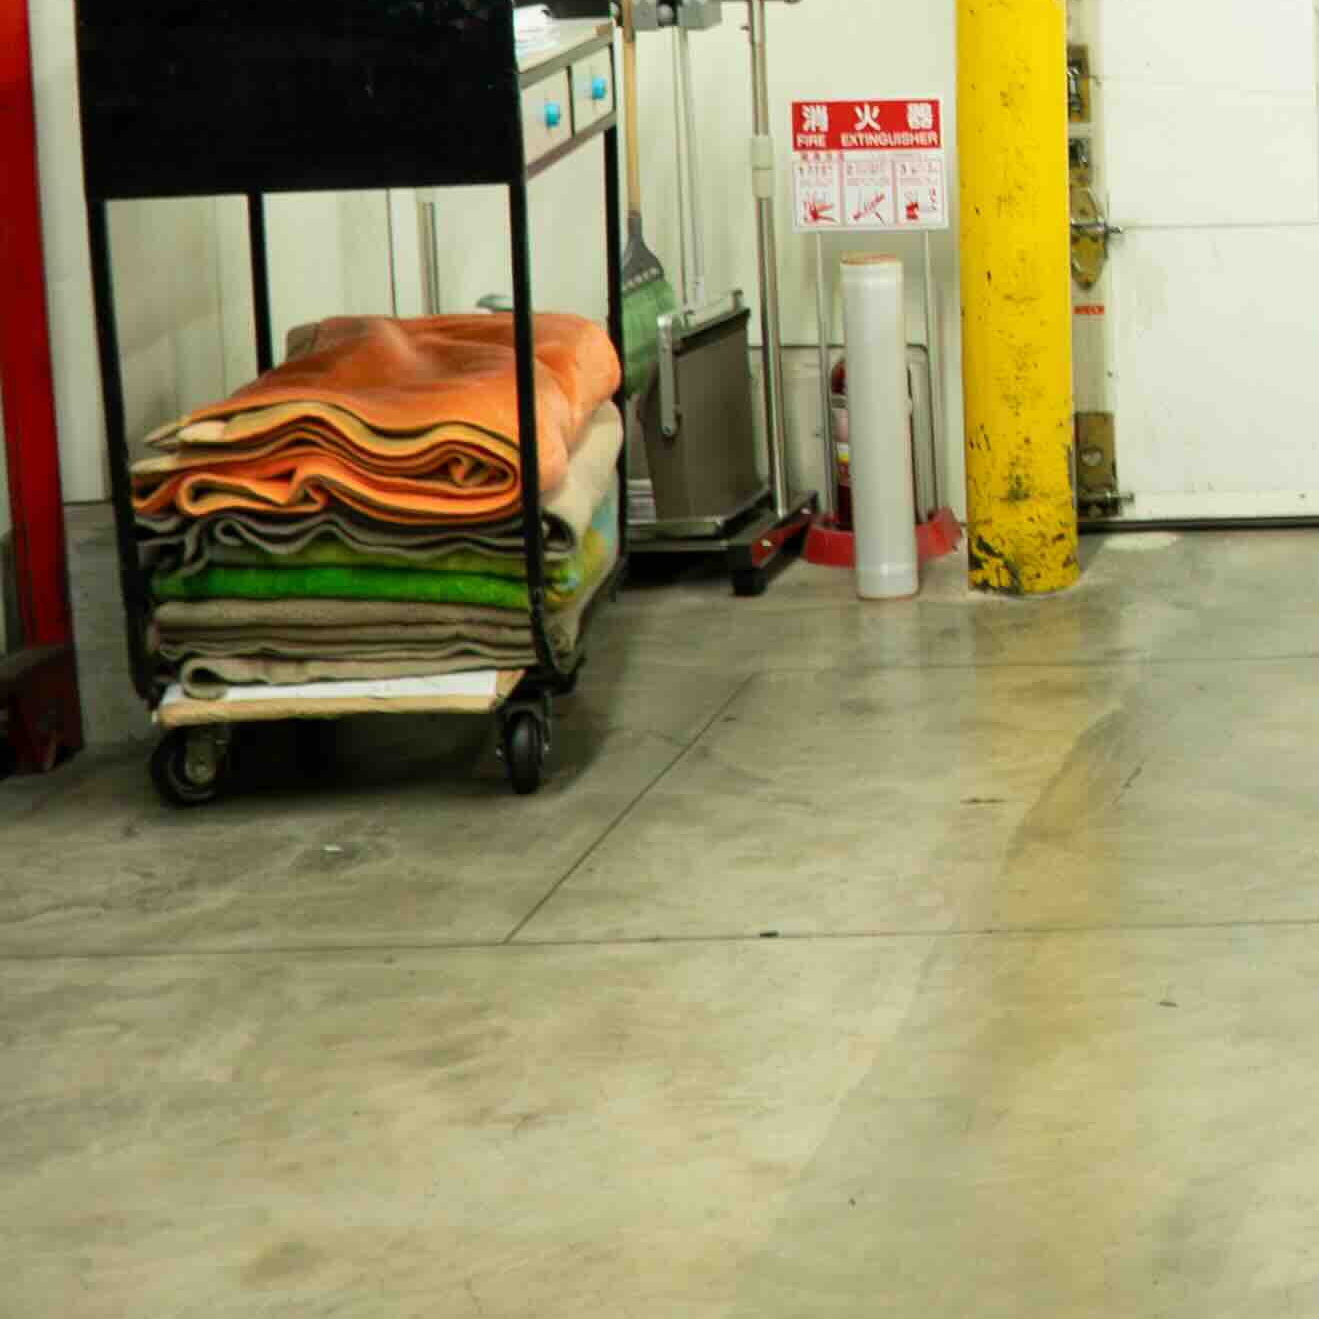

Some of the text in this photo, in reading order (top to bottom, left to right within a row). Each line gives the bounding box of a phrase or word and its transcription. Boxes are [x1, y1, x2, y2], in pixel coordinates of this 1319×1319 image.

[802, 103, 932, 131] 消火器
[797, 132, 938, 147] FIRE EXTINGUISHER
